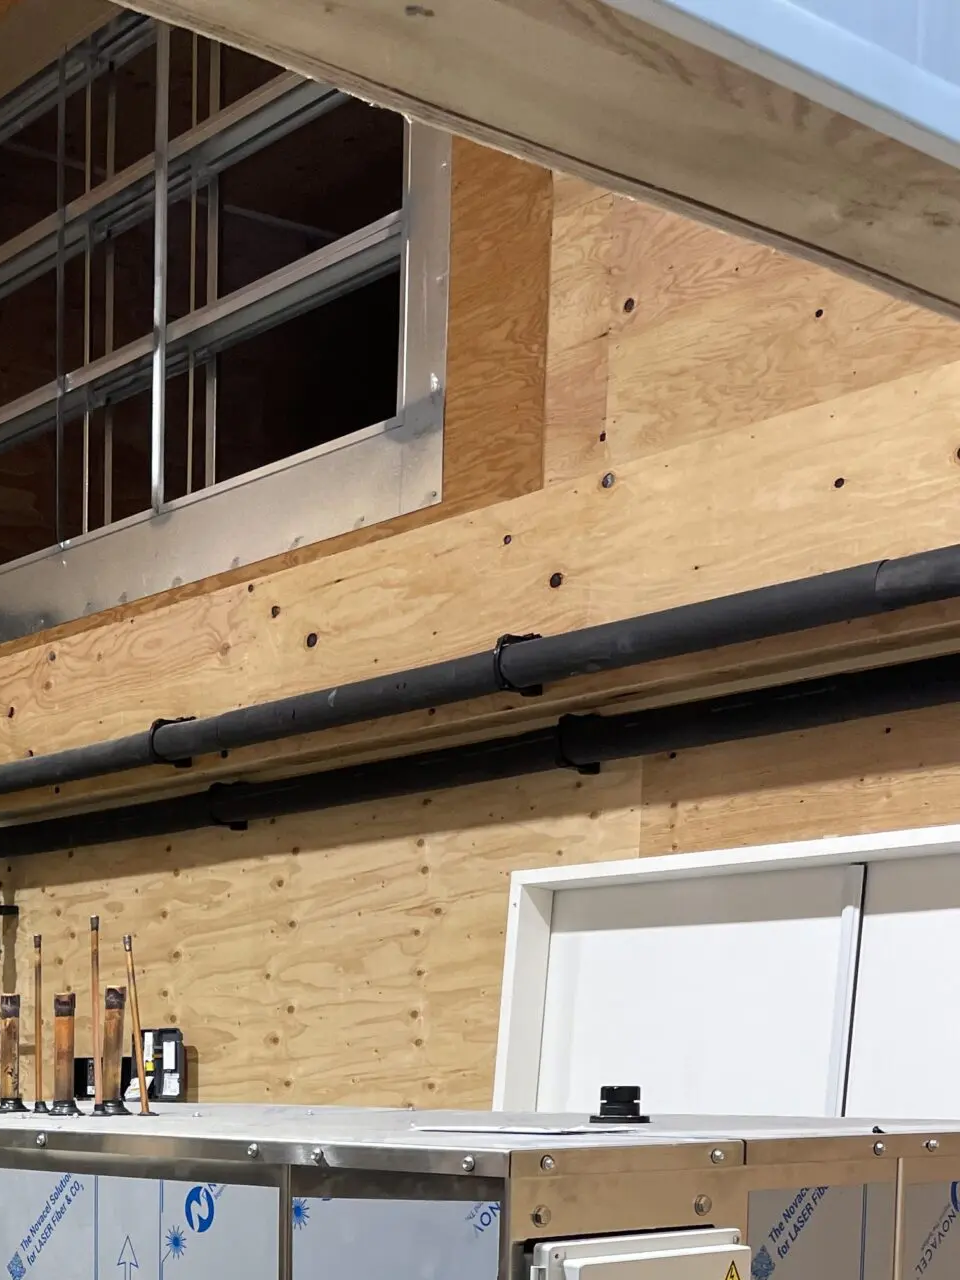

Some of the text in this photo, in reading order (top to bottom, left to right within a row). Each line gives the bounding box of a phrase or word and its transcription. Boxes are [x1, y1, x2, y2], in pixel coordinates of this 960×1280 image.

[20, 1235, 31, 1251] The
[29, 1200, 51, 1237] Novacel
[27, 1250, 36, 1266] for
[34, 1223, 53, 1253] LASER
[51, 1202, 66, 1227] Fiber
[769, 1223, 785, 1243] The
[778, 1203, 814, 1259] for LASER
[916, 1209, 957, 1274] NOVACEL
